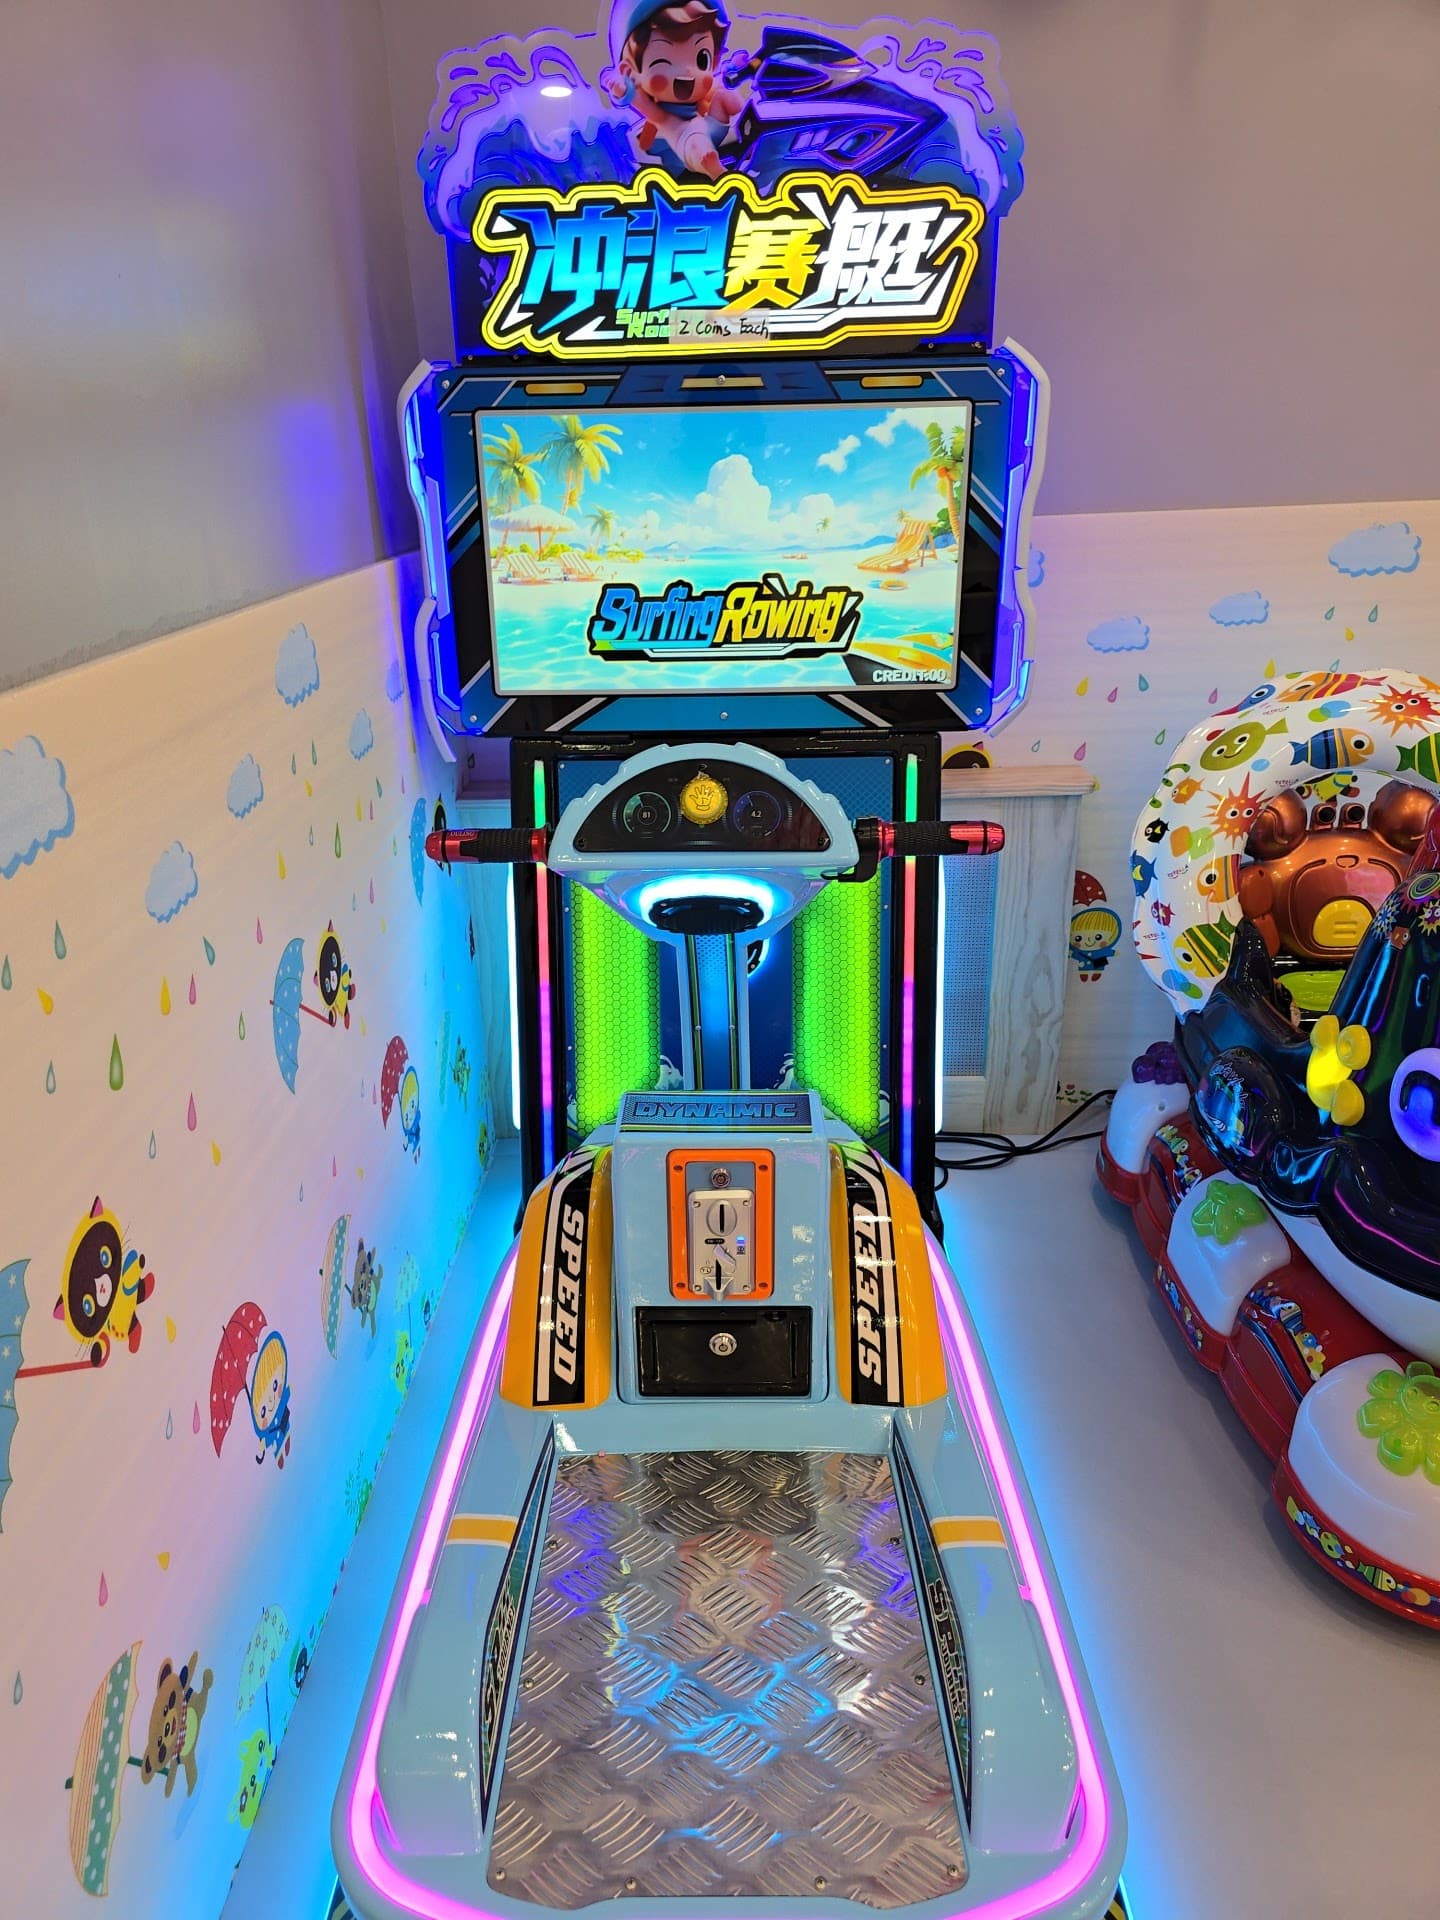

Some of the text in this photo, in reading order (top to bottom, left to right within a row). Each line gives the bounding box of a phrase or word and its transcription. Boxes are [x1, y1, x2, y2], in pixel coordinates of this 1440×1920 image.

[499, 188, 950, 334] 冲浪赛艇
[678, 319, 690, 335] 2
[739, 317, 769, 339] Each
[633, 1102, 798, 1119] DYNAMIC
[552, 1203, 585, 1386] SPEED
[852, 1202, 882, 1387] SPEED
